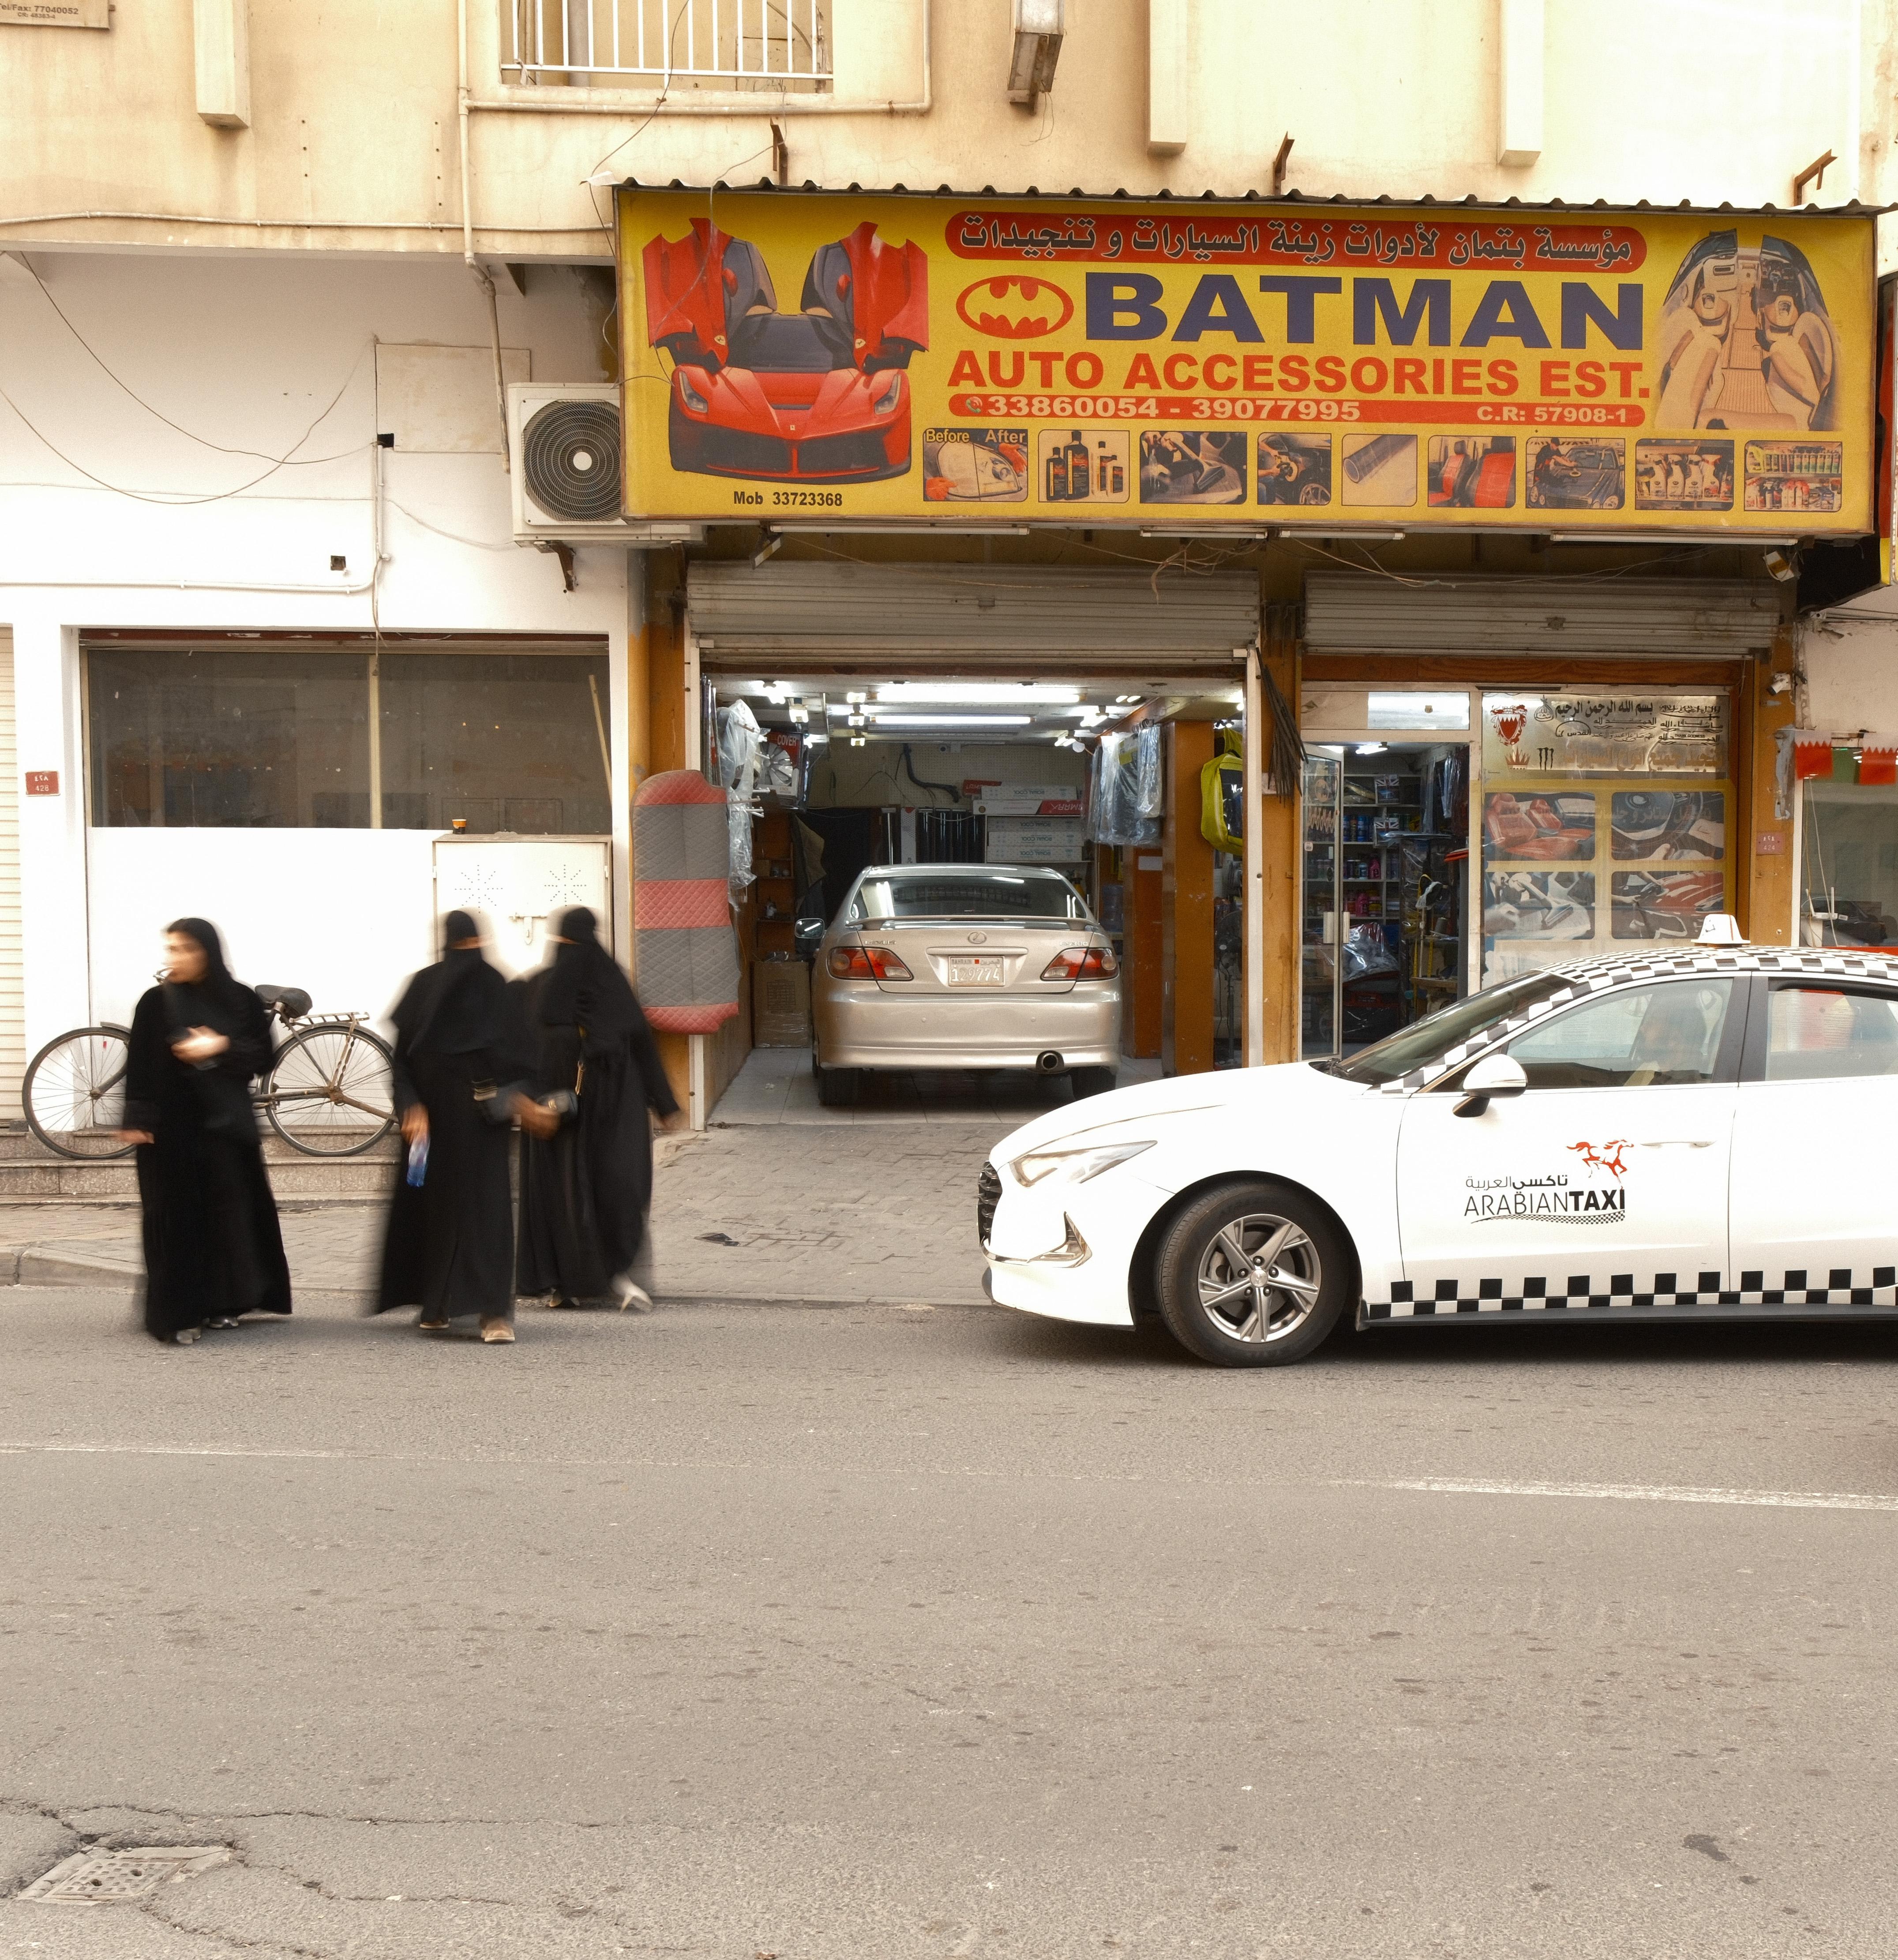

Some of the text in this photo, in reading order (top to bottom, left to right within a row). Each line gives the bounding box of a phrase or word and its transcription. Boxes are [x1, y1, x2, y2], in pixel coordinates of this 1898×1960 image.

[34, 5, 79, 15] 77040052
[960, 215, 1632, 268] مؤسسة بتمان لأدوات زينة السيارات و تنجيدات
[1085, 272, 1643, 351] BATMAN
[947, 350, 1650, 398] AUTO ACCESSORIES EST.
[987, 396, 1159, 418] 33860054
[1192, 398, 1361, 421] 39077995
[1477, 406, 1627, 423] C.R: 57908-1
[926, 428, 1026, 443] Before After
[733, 491, 843, 507] Mob 33723368
[1555, 700, 1583, 718] الرحيم
[1586, 700, 1616, 717] الرحمن
[1619, 700, 1633, 712] الله
[1635, 702, 1653, 716] بسم
[777, 734, 797, 747] COVER
[951, 967, 1000, 982] 129774
